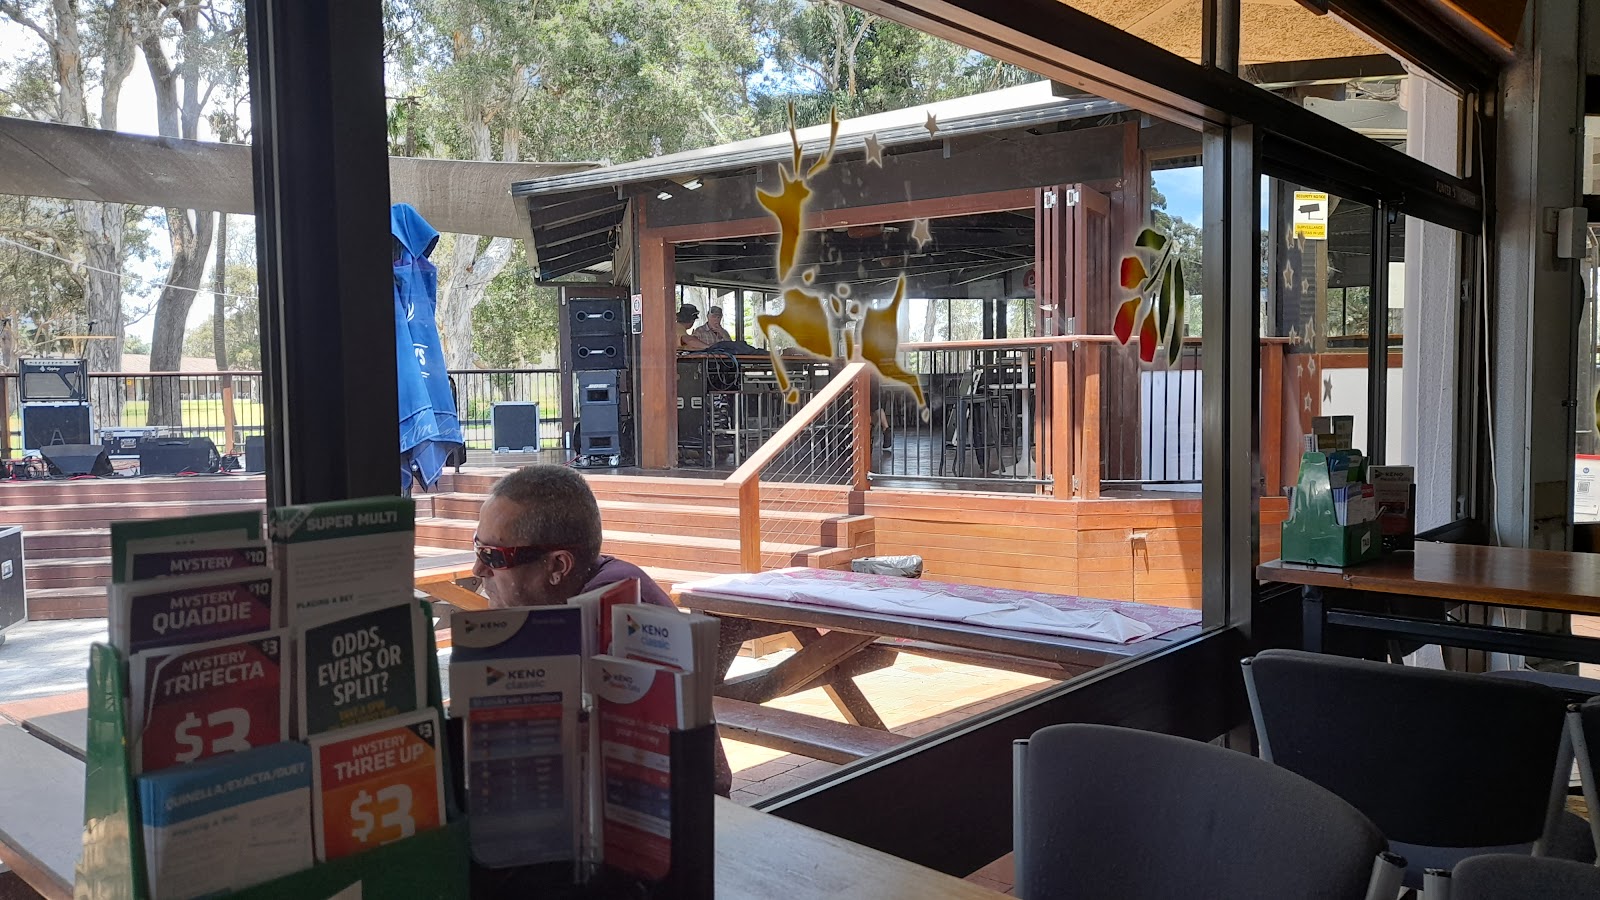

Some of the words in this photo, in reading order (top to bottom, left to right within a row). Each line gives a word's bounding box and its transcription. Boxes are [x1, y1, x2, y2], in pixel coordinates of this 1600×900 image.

[306, 514, 353, 531] SUPER
[357, 511, 398, 526] MULTI
[170, 556, 233, 572] MYSTERY
[245, 550, 265, 563] $10
[248, 582, 269, 595] $10
[170, 590, 237, 609] MYSTERY
[152, 601, 252, 635] QUADDIE
[480, 621, 508, 630] KENO
[332, 625, 386, 657] ODDS,
[641, 623, 669, 638] KENO
[261, 639, 278, 655] $3
[181, 650, 247, 673] MYSTERY
[318, 651, 373, 687] EVENS
[377, 644, 402, 669] OR
[164, 661, 265, 696] TRIFECTA
[508, 668, 546, 679] KENO
[333, 671, 389, 706] SPLIT?
[174, 707, 252, 764] $3
[419, 723, 433, 739] $3
[352, 734, 407, 757] MYSTERY
[334, 749, 396, 782] THREE
[400, 743, 424, 764] UP
[350, 783, 416, 845] $3
